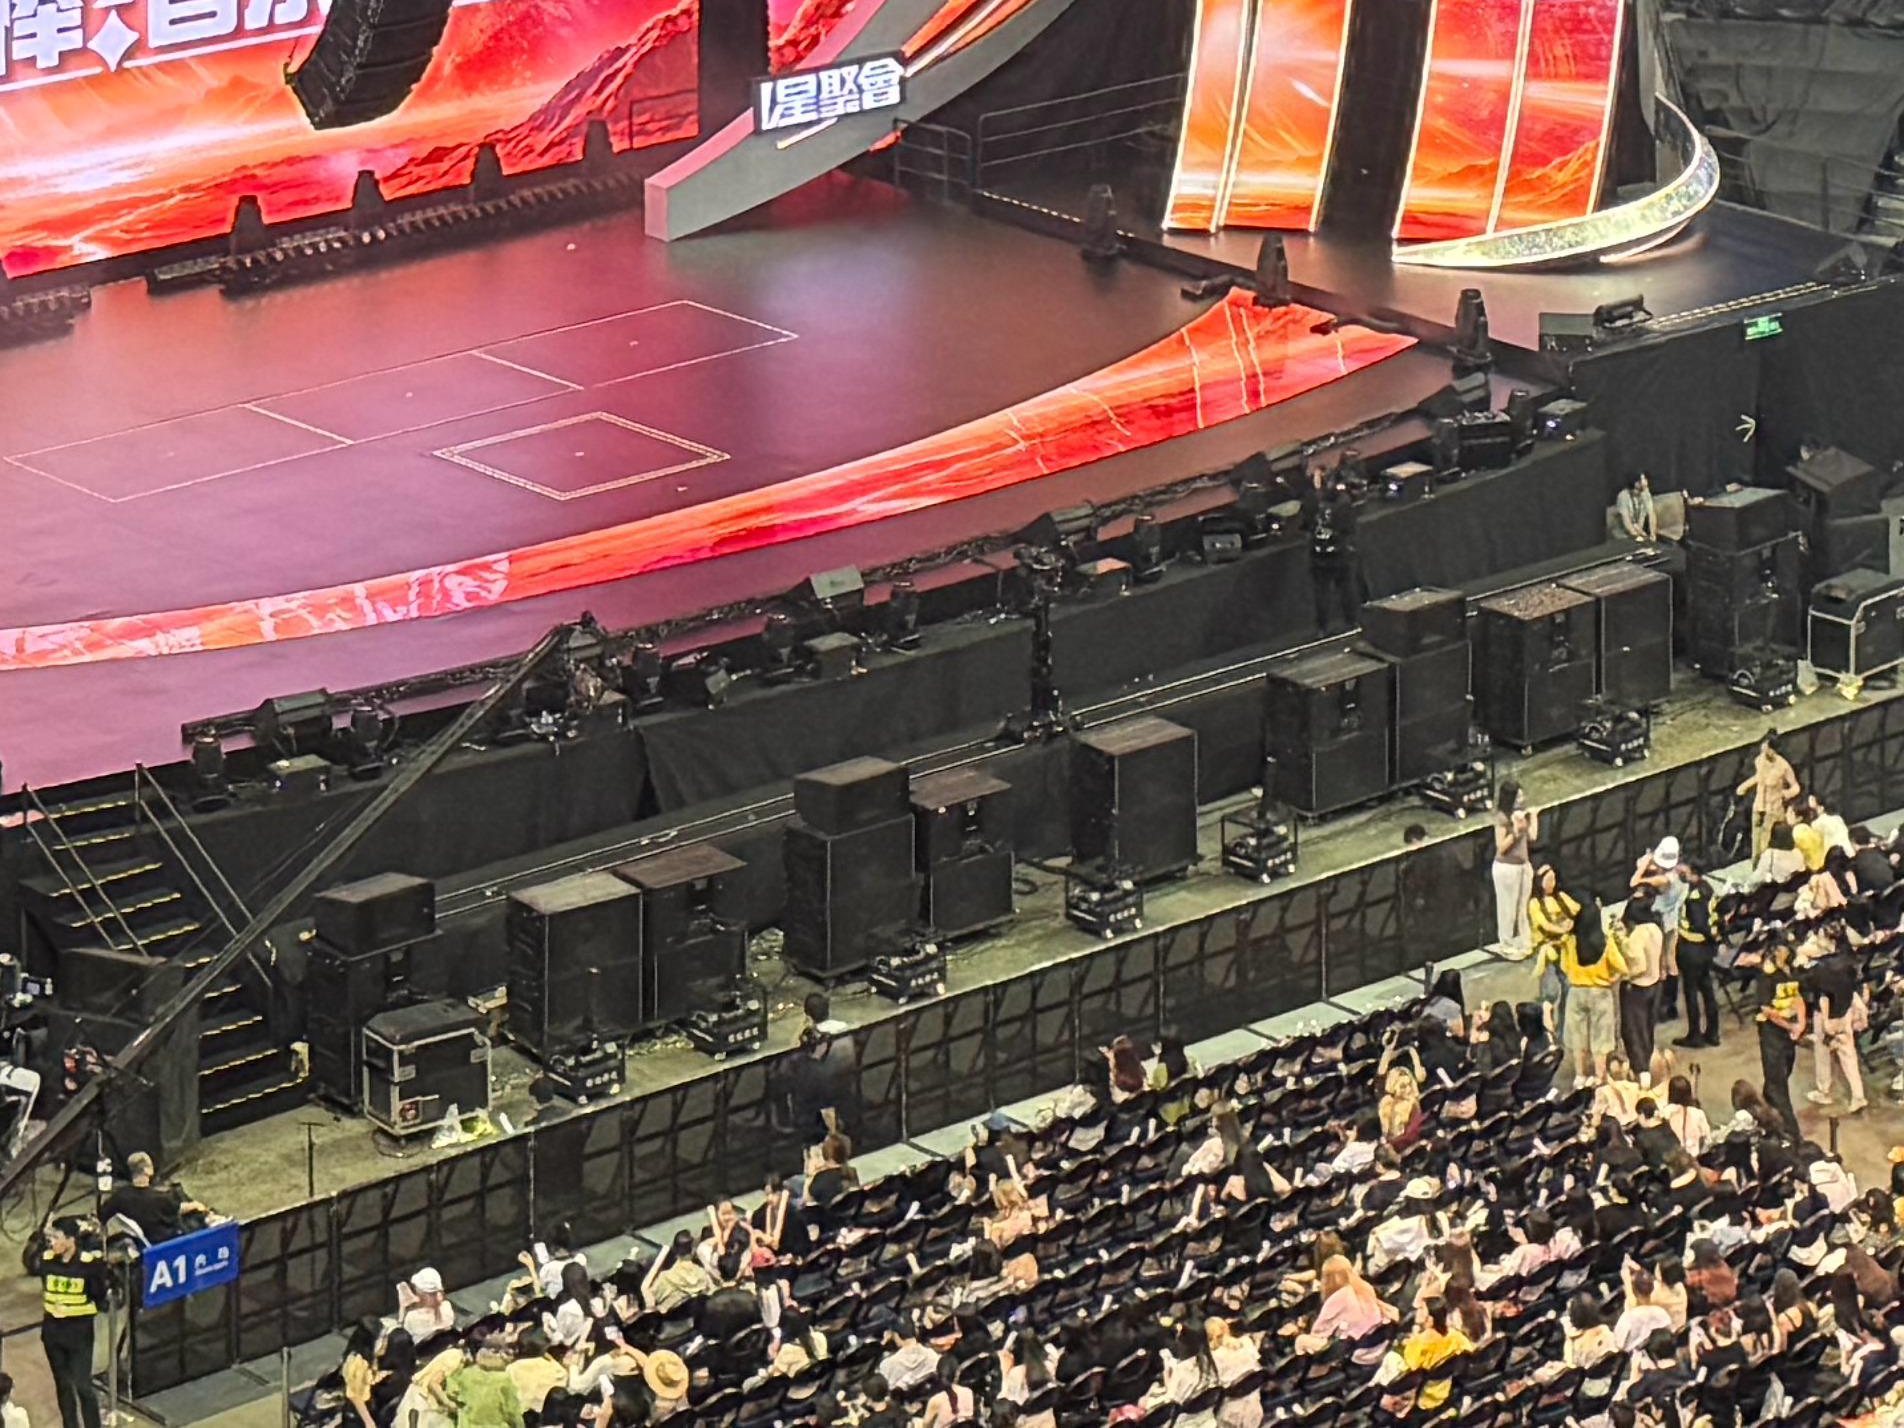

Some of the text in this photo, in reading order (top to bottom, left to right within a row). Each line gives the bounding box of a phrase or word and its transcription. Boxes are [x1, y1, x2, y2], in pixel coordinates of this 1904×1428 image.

[761, 56, 905, 131] 星聚會
[150, 1254, 186, 1293] A1
